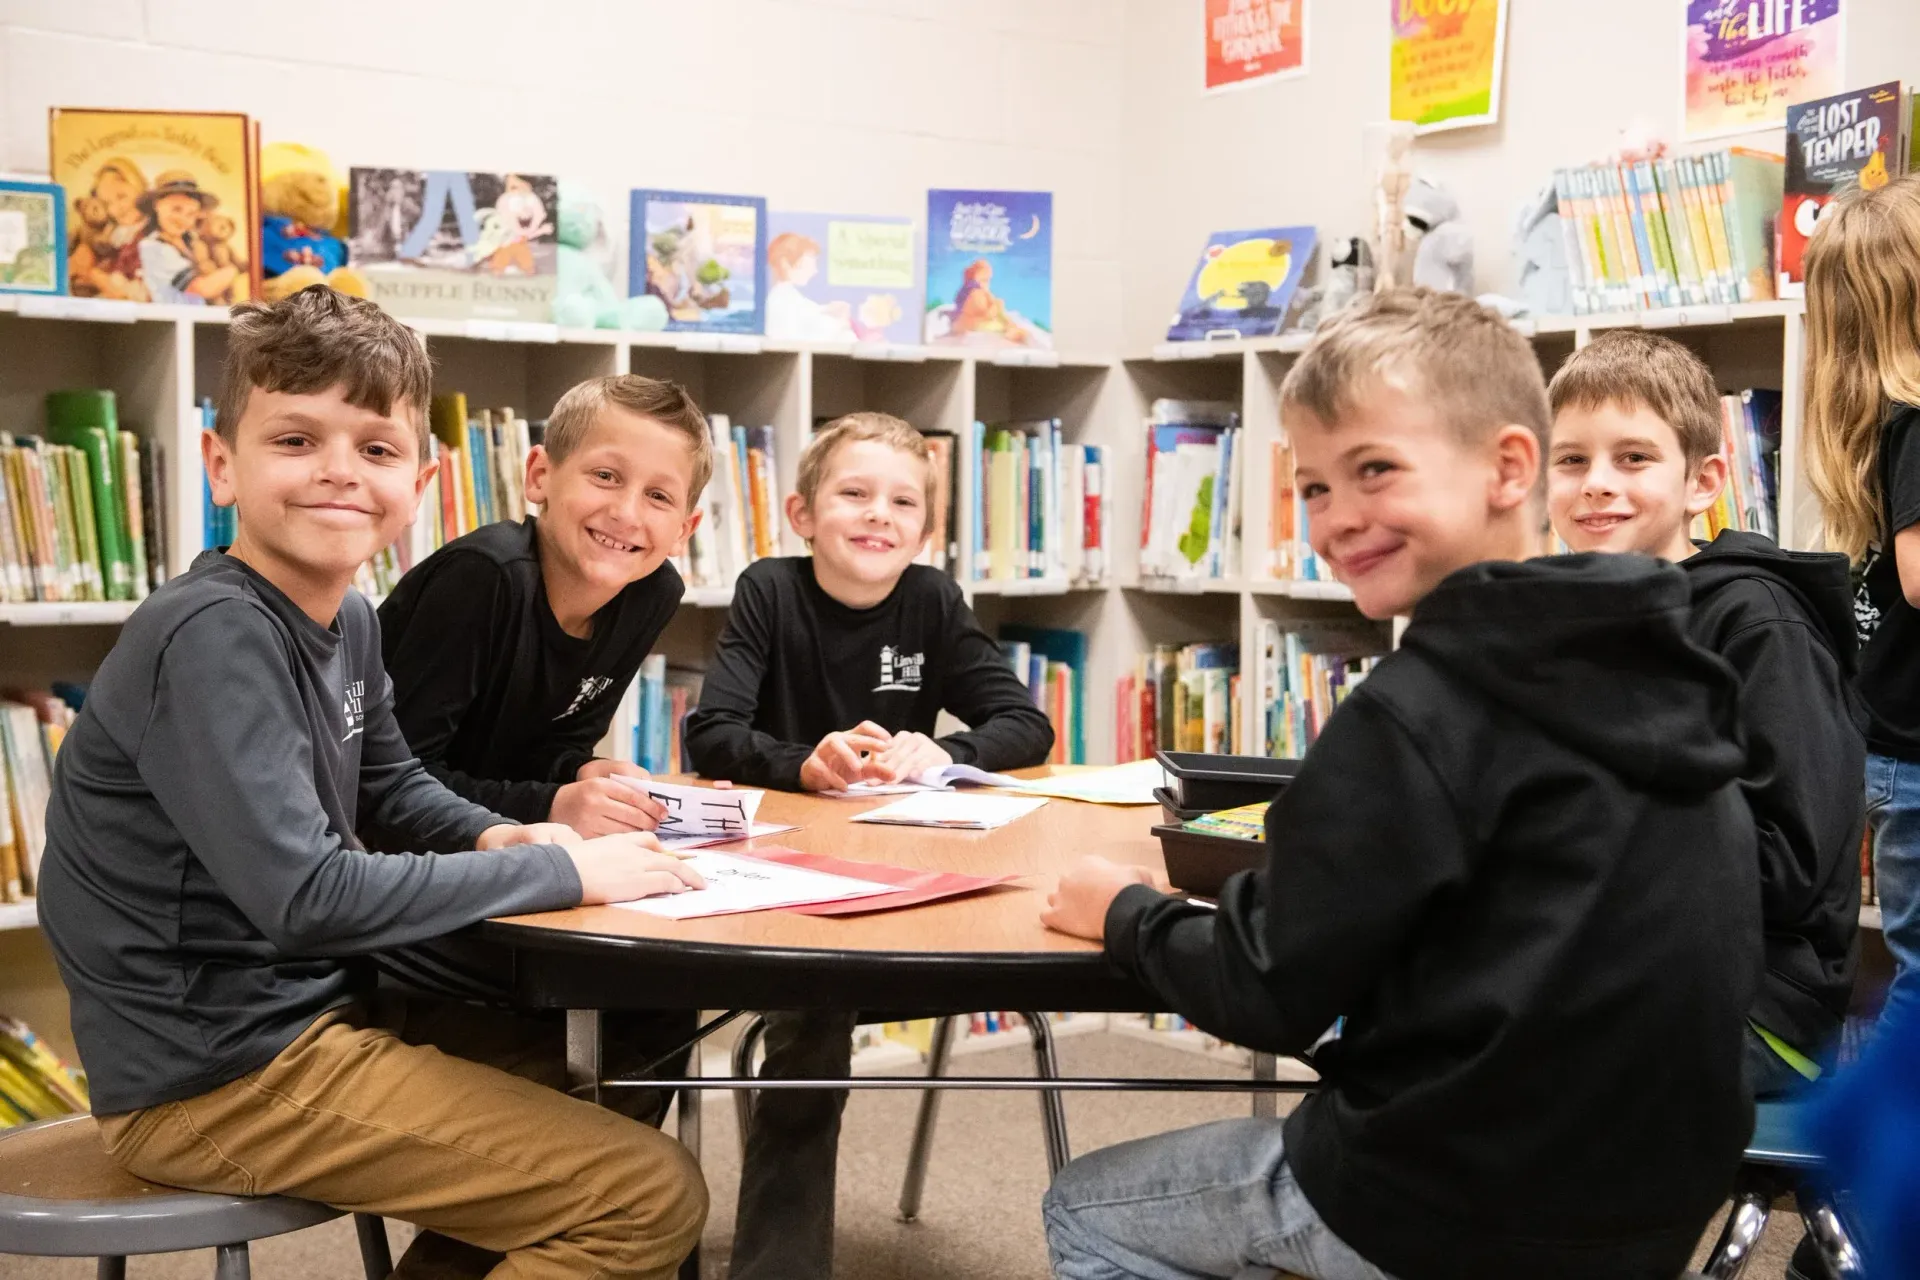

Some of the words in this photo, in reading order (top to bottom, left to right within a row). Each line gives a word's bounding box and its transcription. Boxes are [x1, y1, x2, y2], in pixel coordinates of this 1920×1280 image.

[1817, 97, 1862, 138] LOST
[1802, 116, 1881, 168] TEMPER
[472, 281, 552, 303] BUNNY
